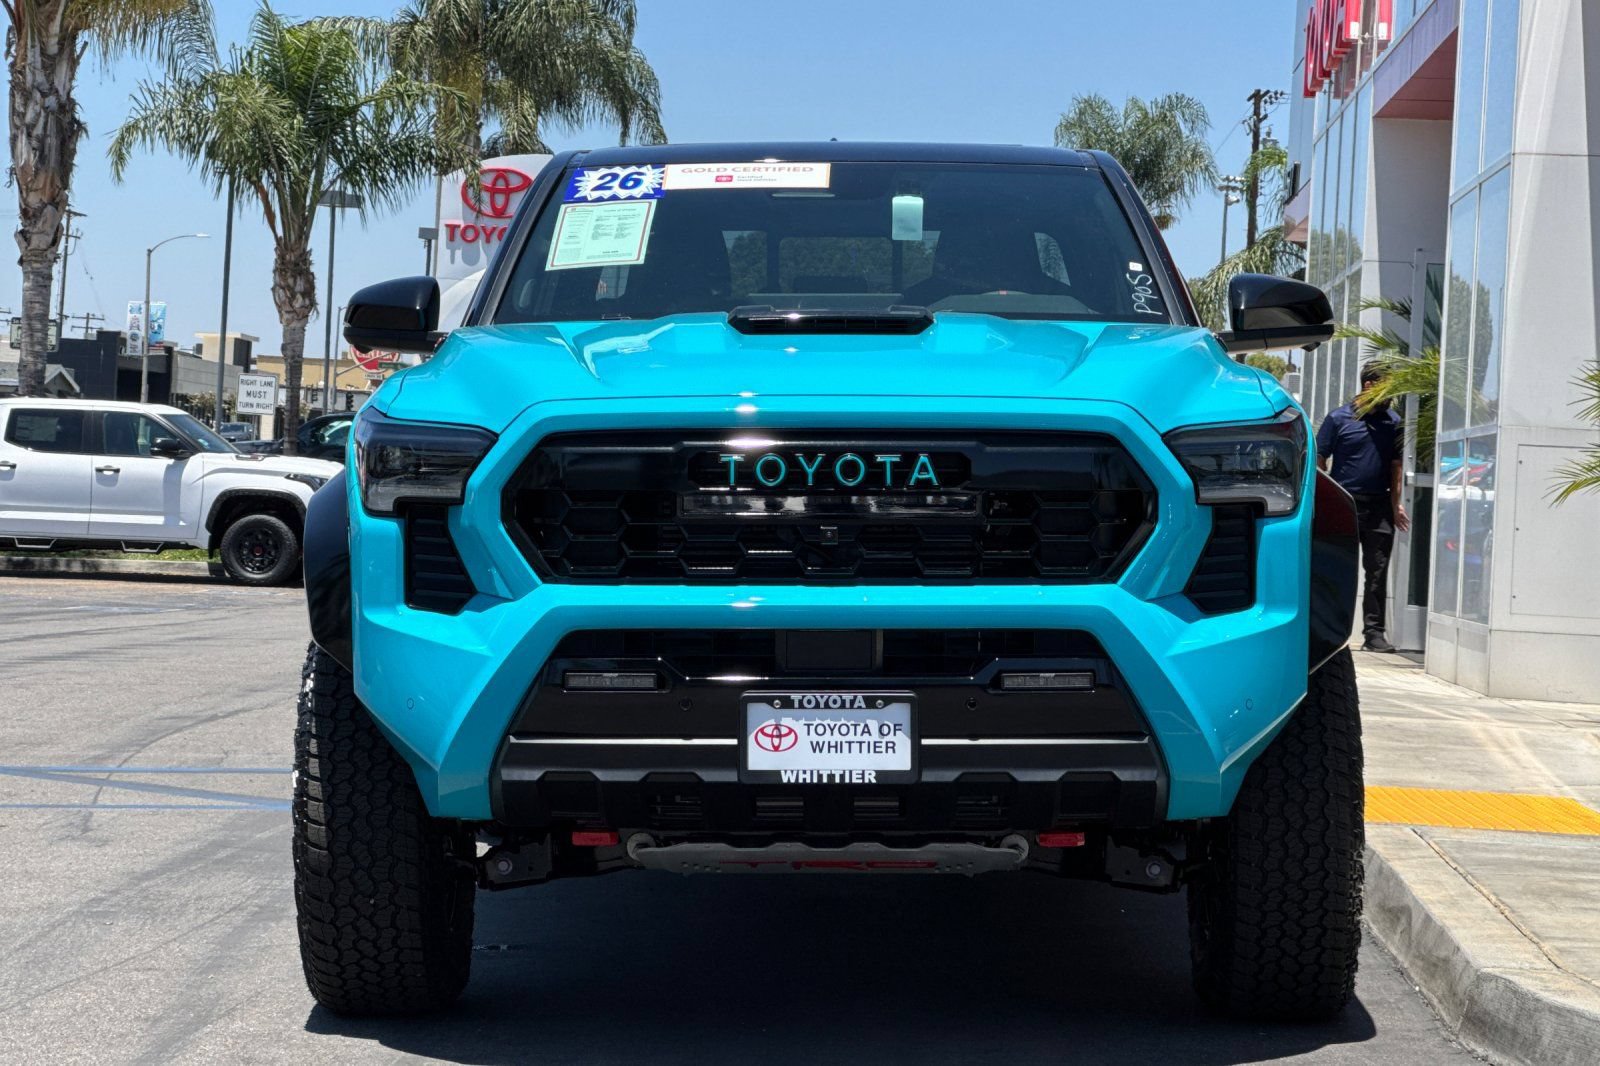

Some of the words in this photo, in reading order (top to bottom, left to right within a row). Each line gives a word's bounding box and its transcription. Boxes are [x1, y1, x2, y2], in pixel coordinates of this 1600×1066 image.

[590, 171, 645, 192] 26
[240, 378, 258, 386] RIGHT
[259, 380, 274, 388] LANE
[246, 389, 267, 399] MUST
[255, 402, 273, 410] RIGHT
[719, 452, 940, 487] TOYOTA
[790, 695, 866, 709] TOYOTA
[803, 723, 870, 737] TOYOTA
[878, 723, 903, 737] OF
[810, 741, 897, 754] WHITTIER
[780, 769, 877, 783] WHITTIER
